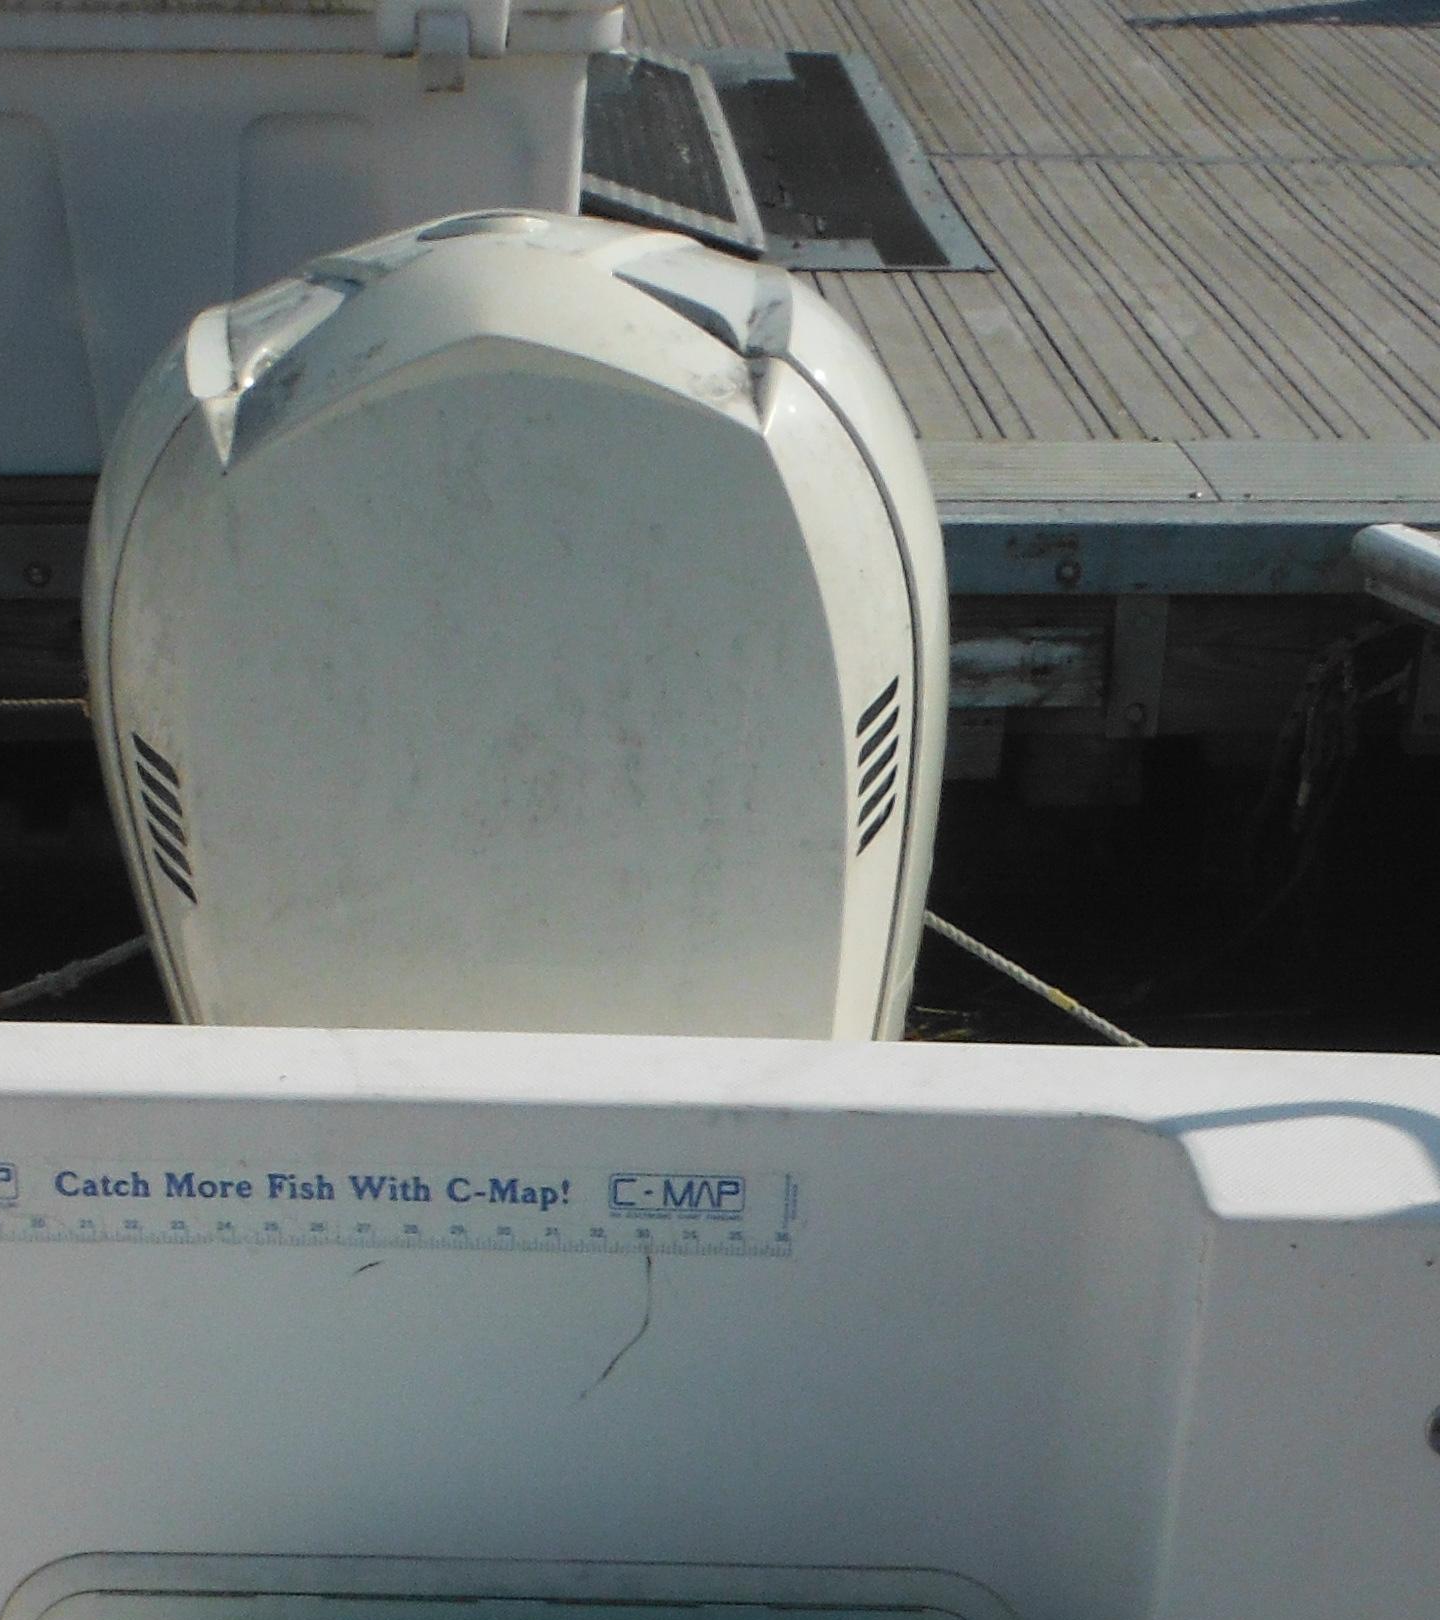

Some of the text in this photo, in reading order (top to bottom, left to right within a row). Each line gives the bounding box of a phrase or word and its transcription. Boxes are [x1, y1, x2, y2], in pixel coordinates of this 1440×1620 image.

[54, 1170, 570, 1212] Catch More Fish With C-Map!
[612, 1178, 741, 1209] C-MAP
